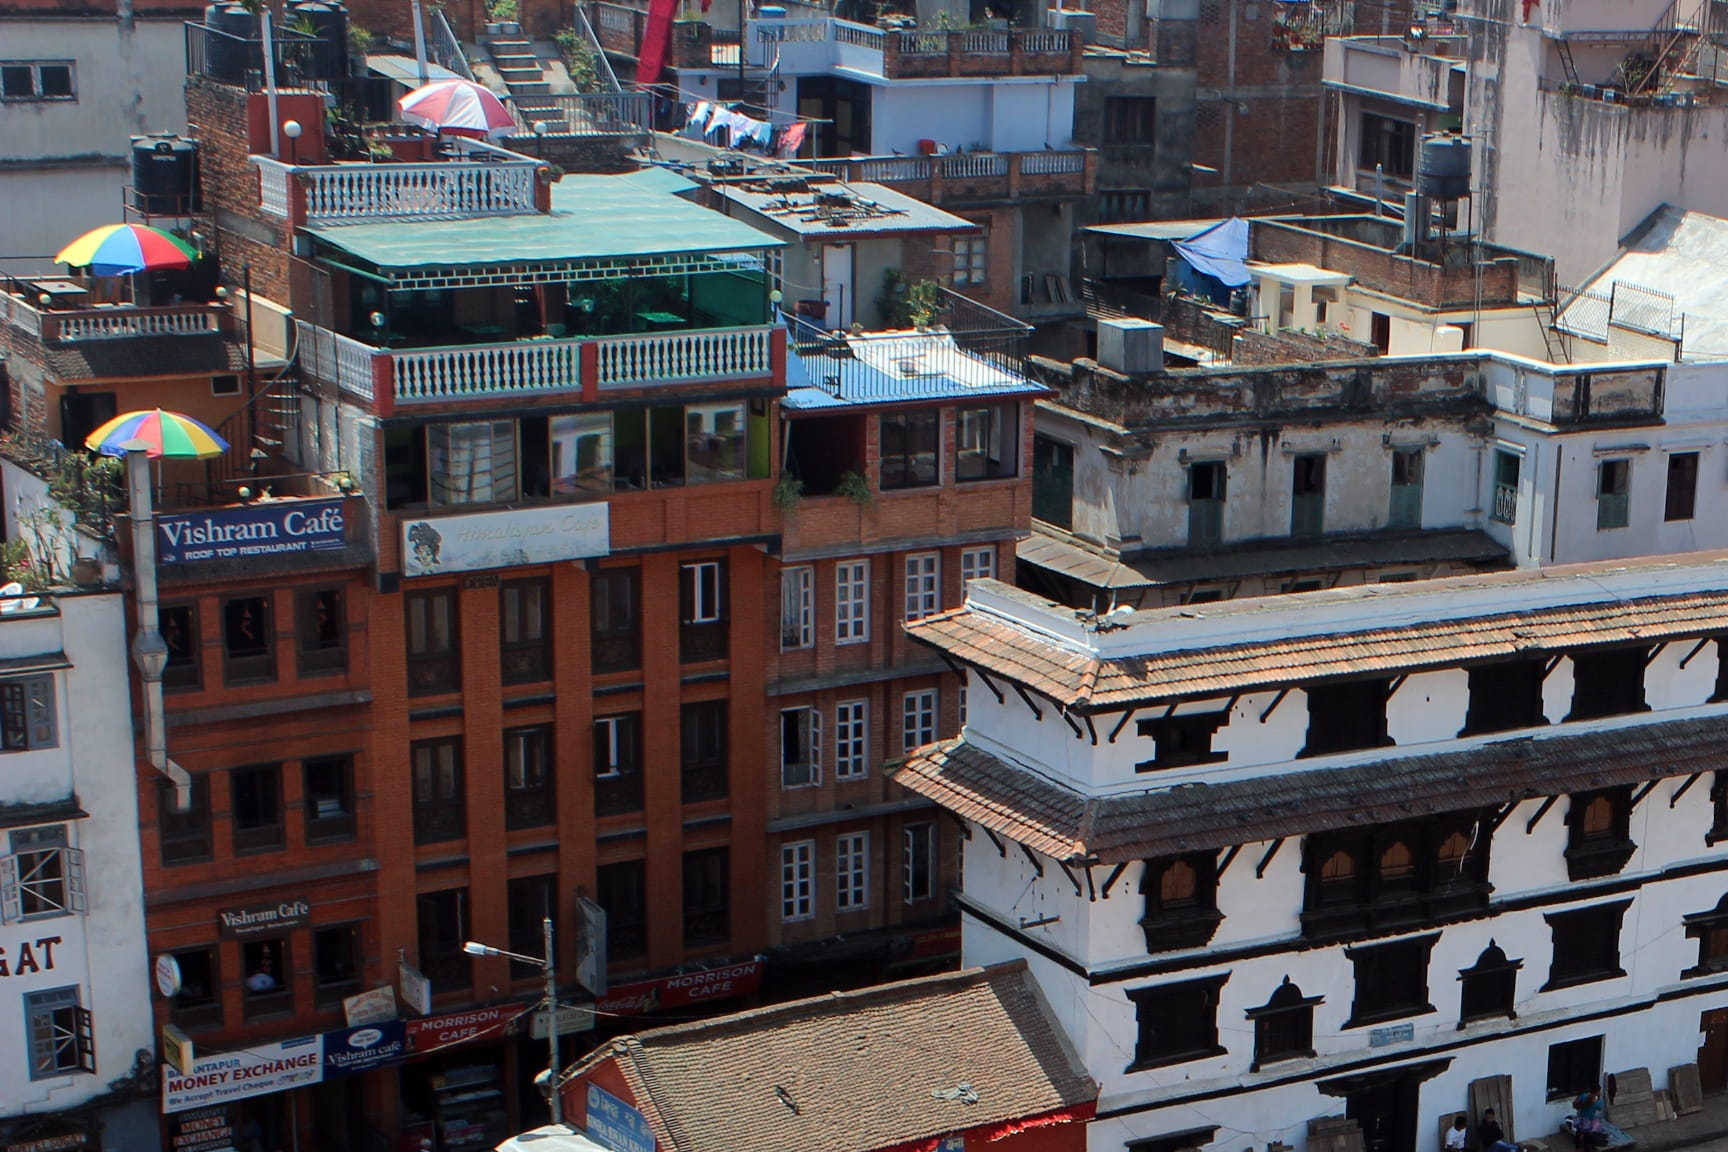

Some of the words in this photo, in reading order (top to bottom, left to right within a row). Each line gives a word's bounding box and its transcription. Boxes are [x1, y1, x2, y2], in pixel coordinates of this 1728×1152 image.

[159, 519, 279, 547] Vishram
[284, 508, 344, 536] Café
[185, 549, 214, 561] ROOF
[218, 547, 239, 558] TOP
[240, 542, 307, 555] RESTAURANT
[221, 910, 277, 926] Vishram
[668, 965, 756, 990] MORRISON
[688, 981, 732, 997] CAFE
[422, 1010, 499, 1031] MORRISON
[440, 1027, 478, 1041] CAFE
[329, 1049, 376, 1064] Vishram
[168, 1058, 241, 1079] BANTAPUR
[168, 1071, 228, 1093] MONEY
[233, 1053, 317, 1081] EXCHANGE
[169, 1096, 182, 1105] We
[184, 1091, 213, 1103] Accept
[215, 1085, 240, 1096] Travel
